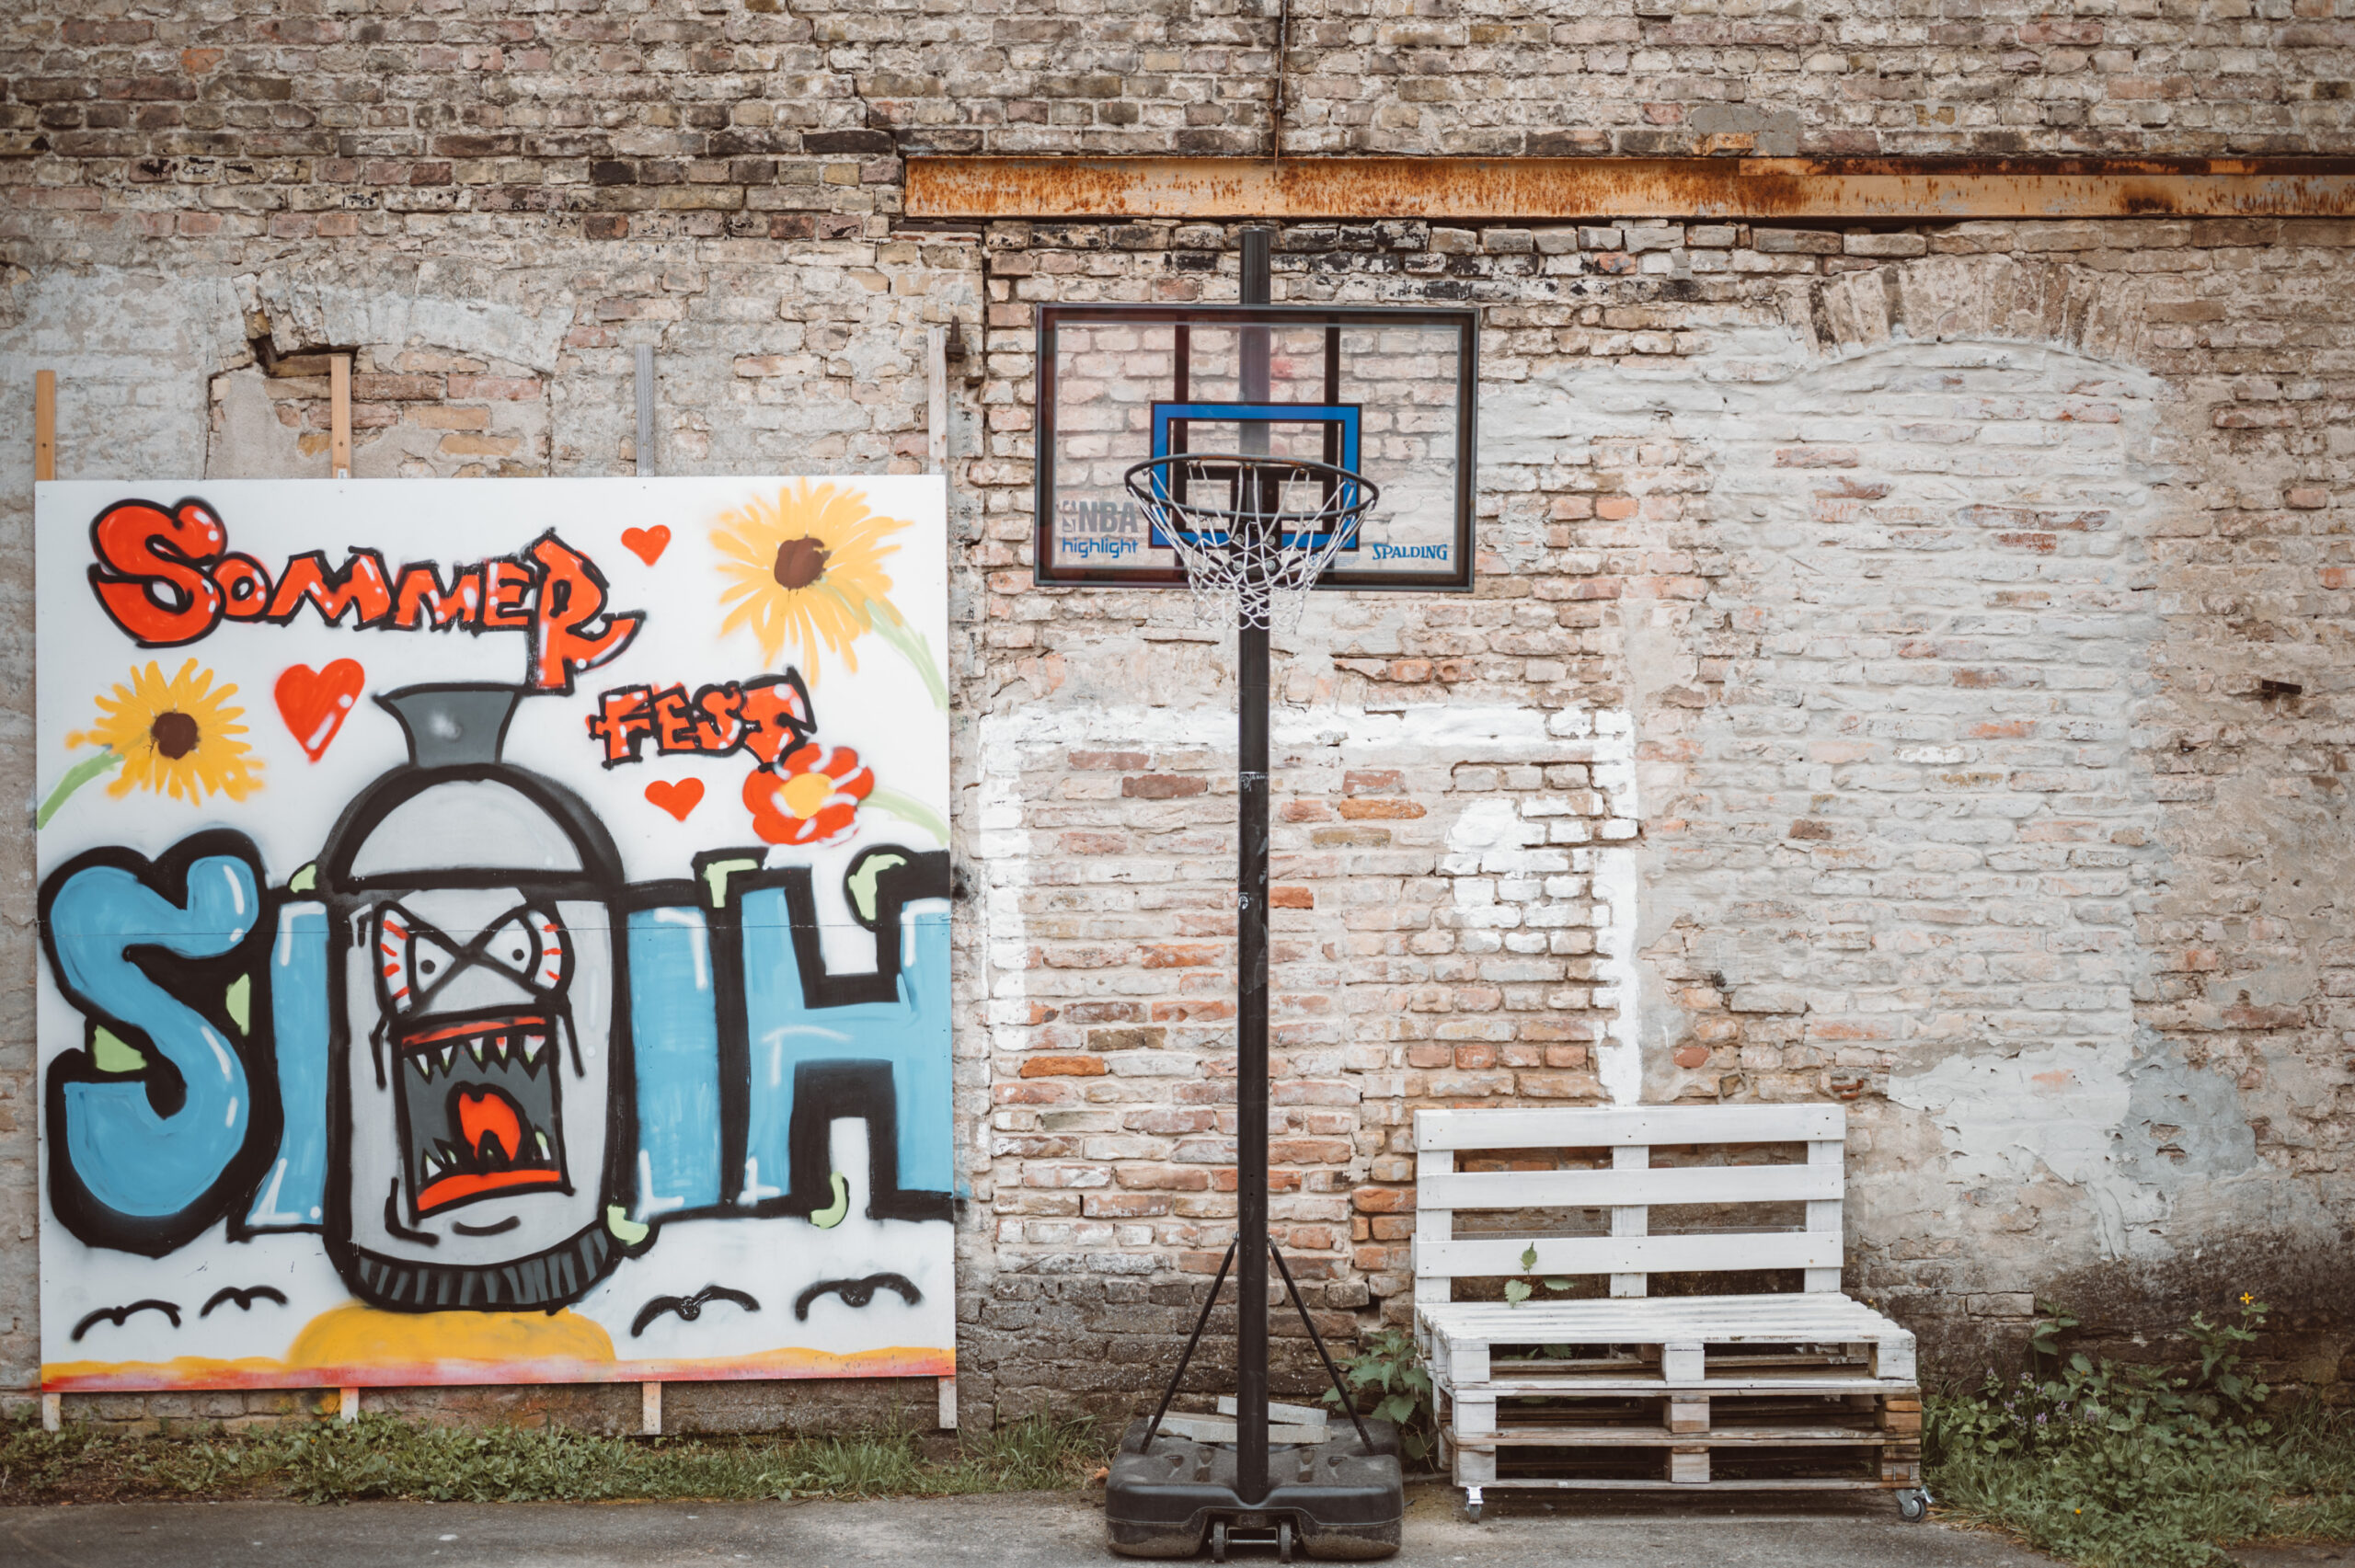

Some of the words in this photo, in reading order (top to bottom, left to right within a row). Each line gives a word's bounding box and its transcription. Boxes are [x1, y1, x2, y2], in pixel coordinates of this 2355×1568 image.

[1079, 501, 1139, 532] NBA
[1062, 537, 1139, 559] highlight
[1372, 543, 1448, 561] SPALDING
[87, 497, 647, 696] SOMMER
[586, 664, 817, 771] FEST
